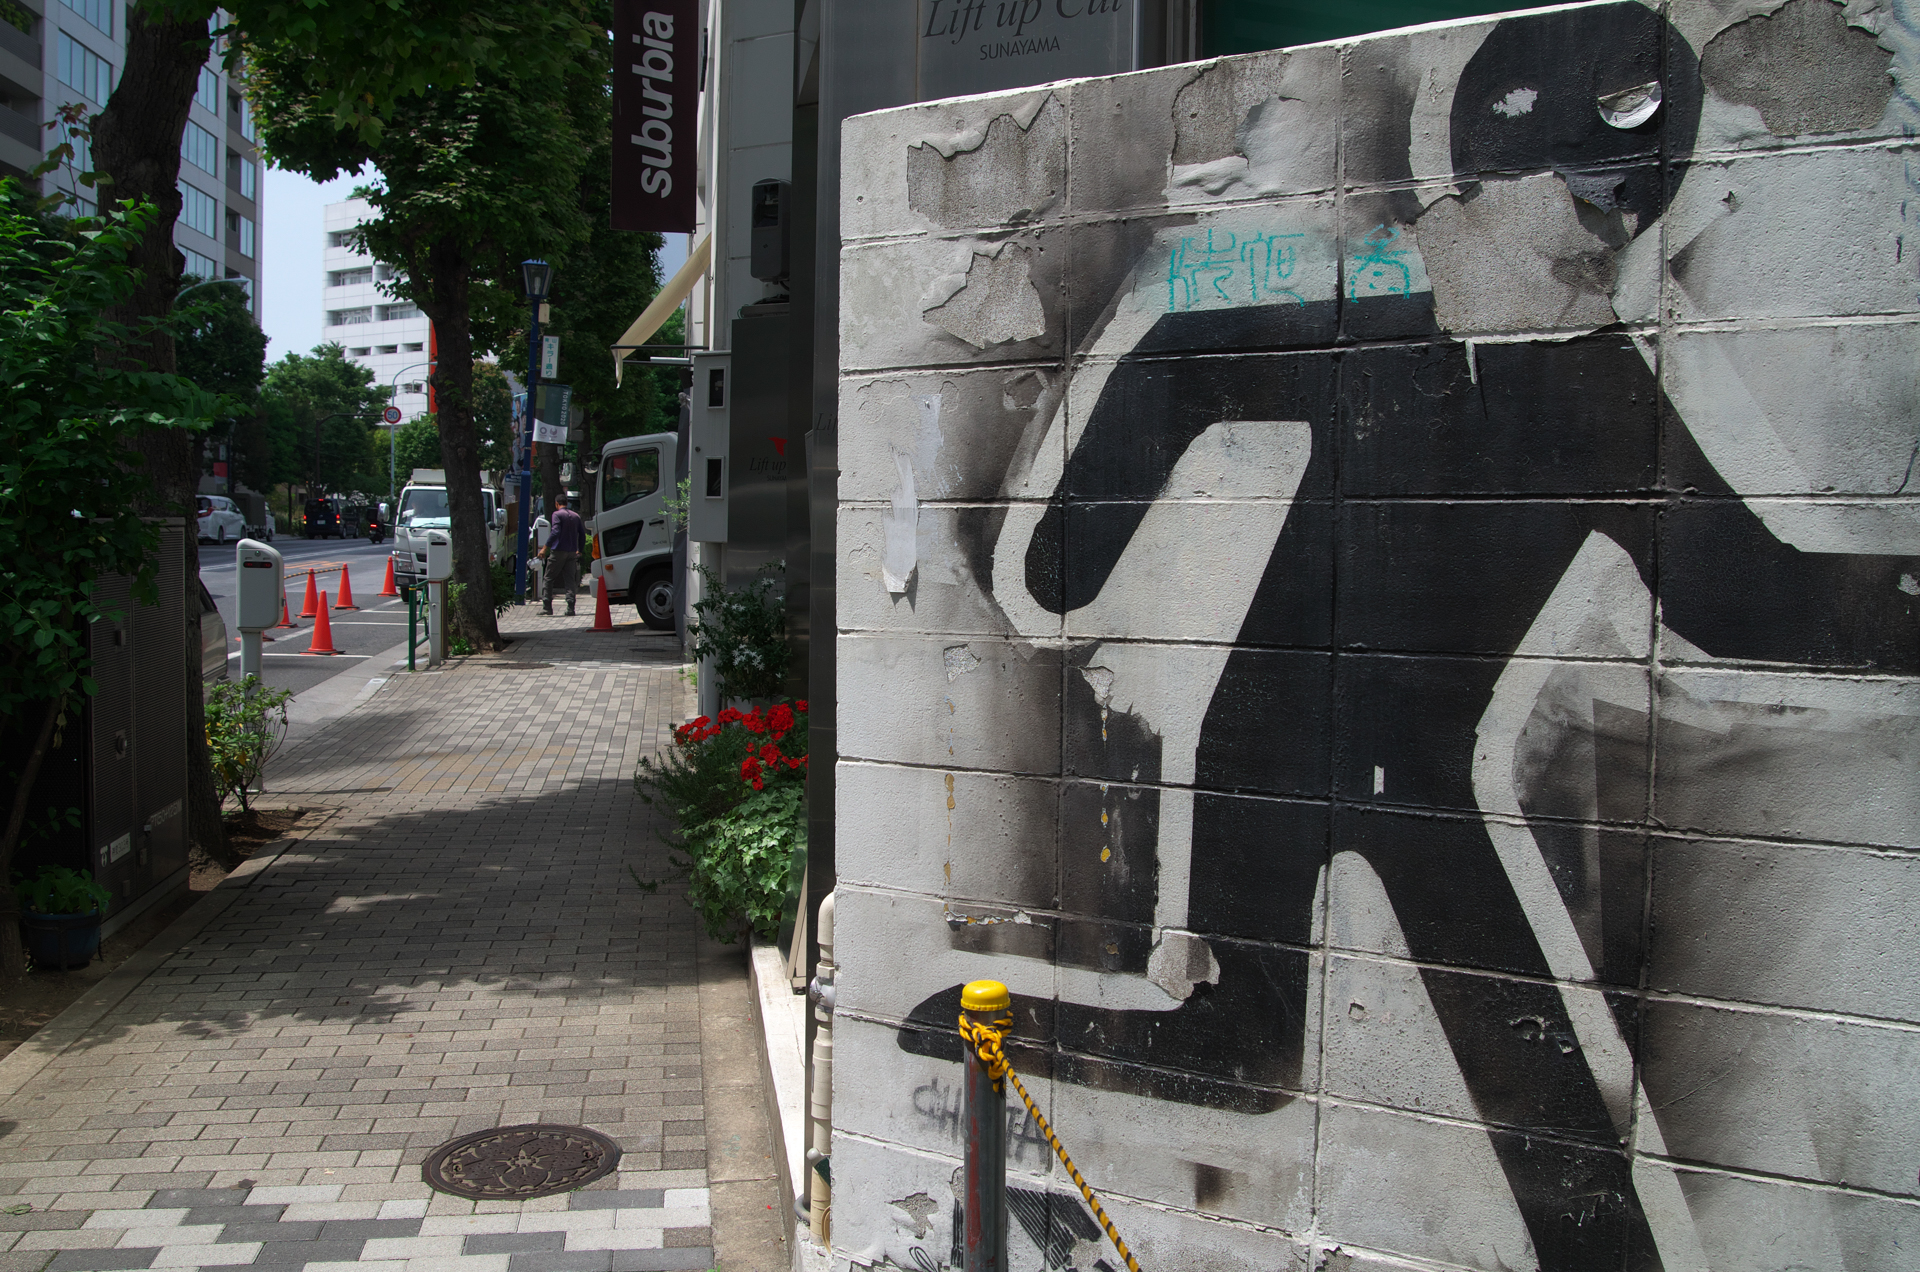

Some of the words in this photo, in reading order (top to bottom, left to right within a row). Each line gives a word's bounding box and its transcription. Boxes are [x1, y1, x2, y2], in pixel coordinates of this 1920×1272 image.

[922, 0, 986, 45] Lift
[996, 0, 1042, 37] up
[979, 35, 1061, 61] SUNAYAMA
[631, 11, 674, 198] suburbia
[561, 391, 569, 410] TOKYO
[387, 411, 398, 419] 50
[749, 457, 769, 475] Lift
[772, 461, 787, 475] up
